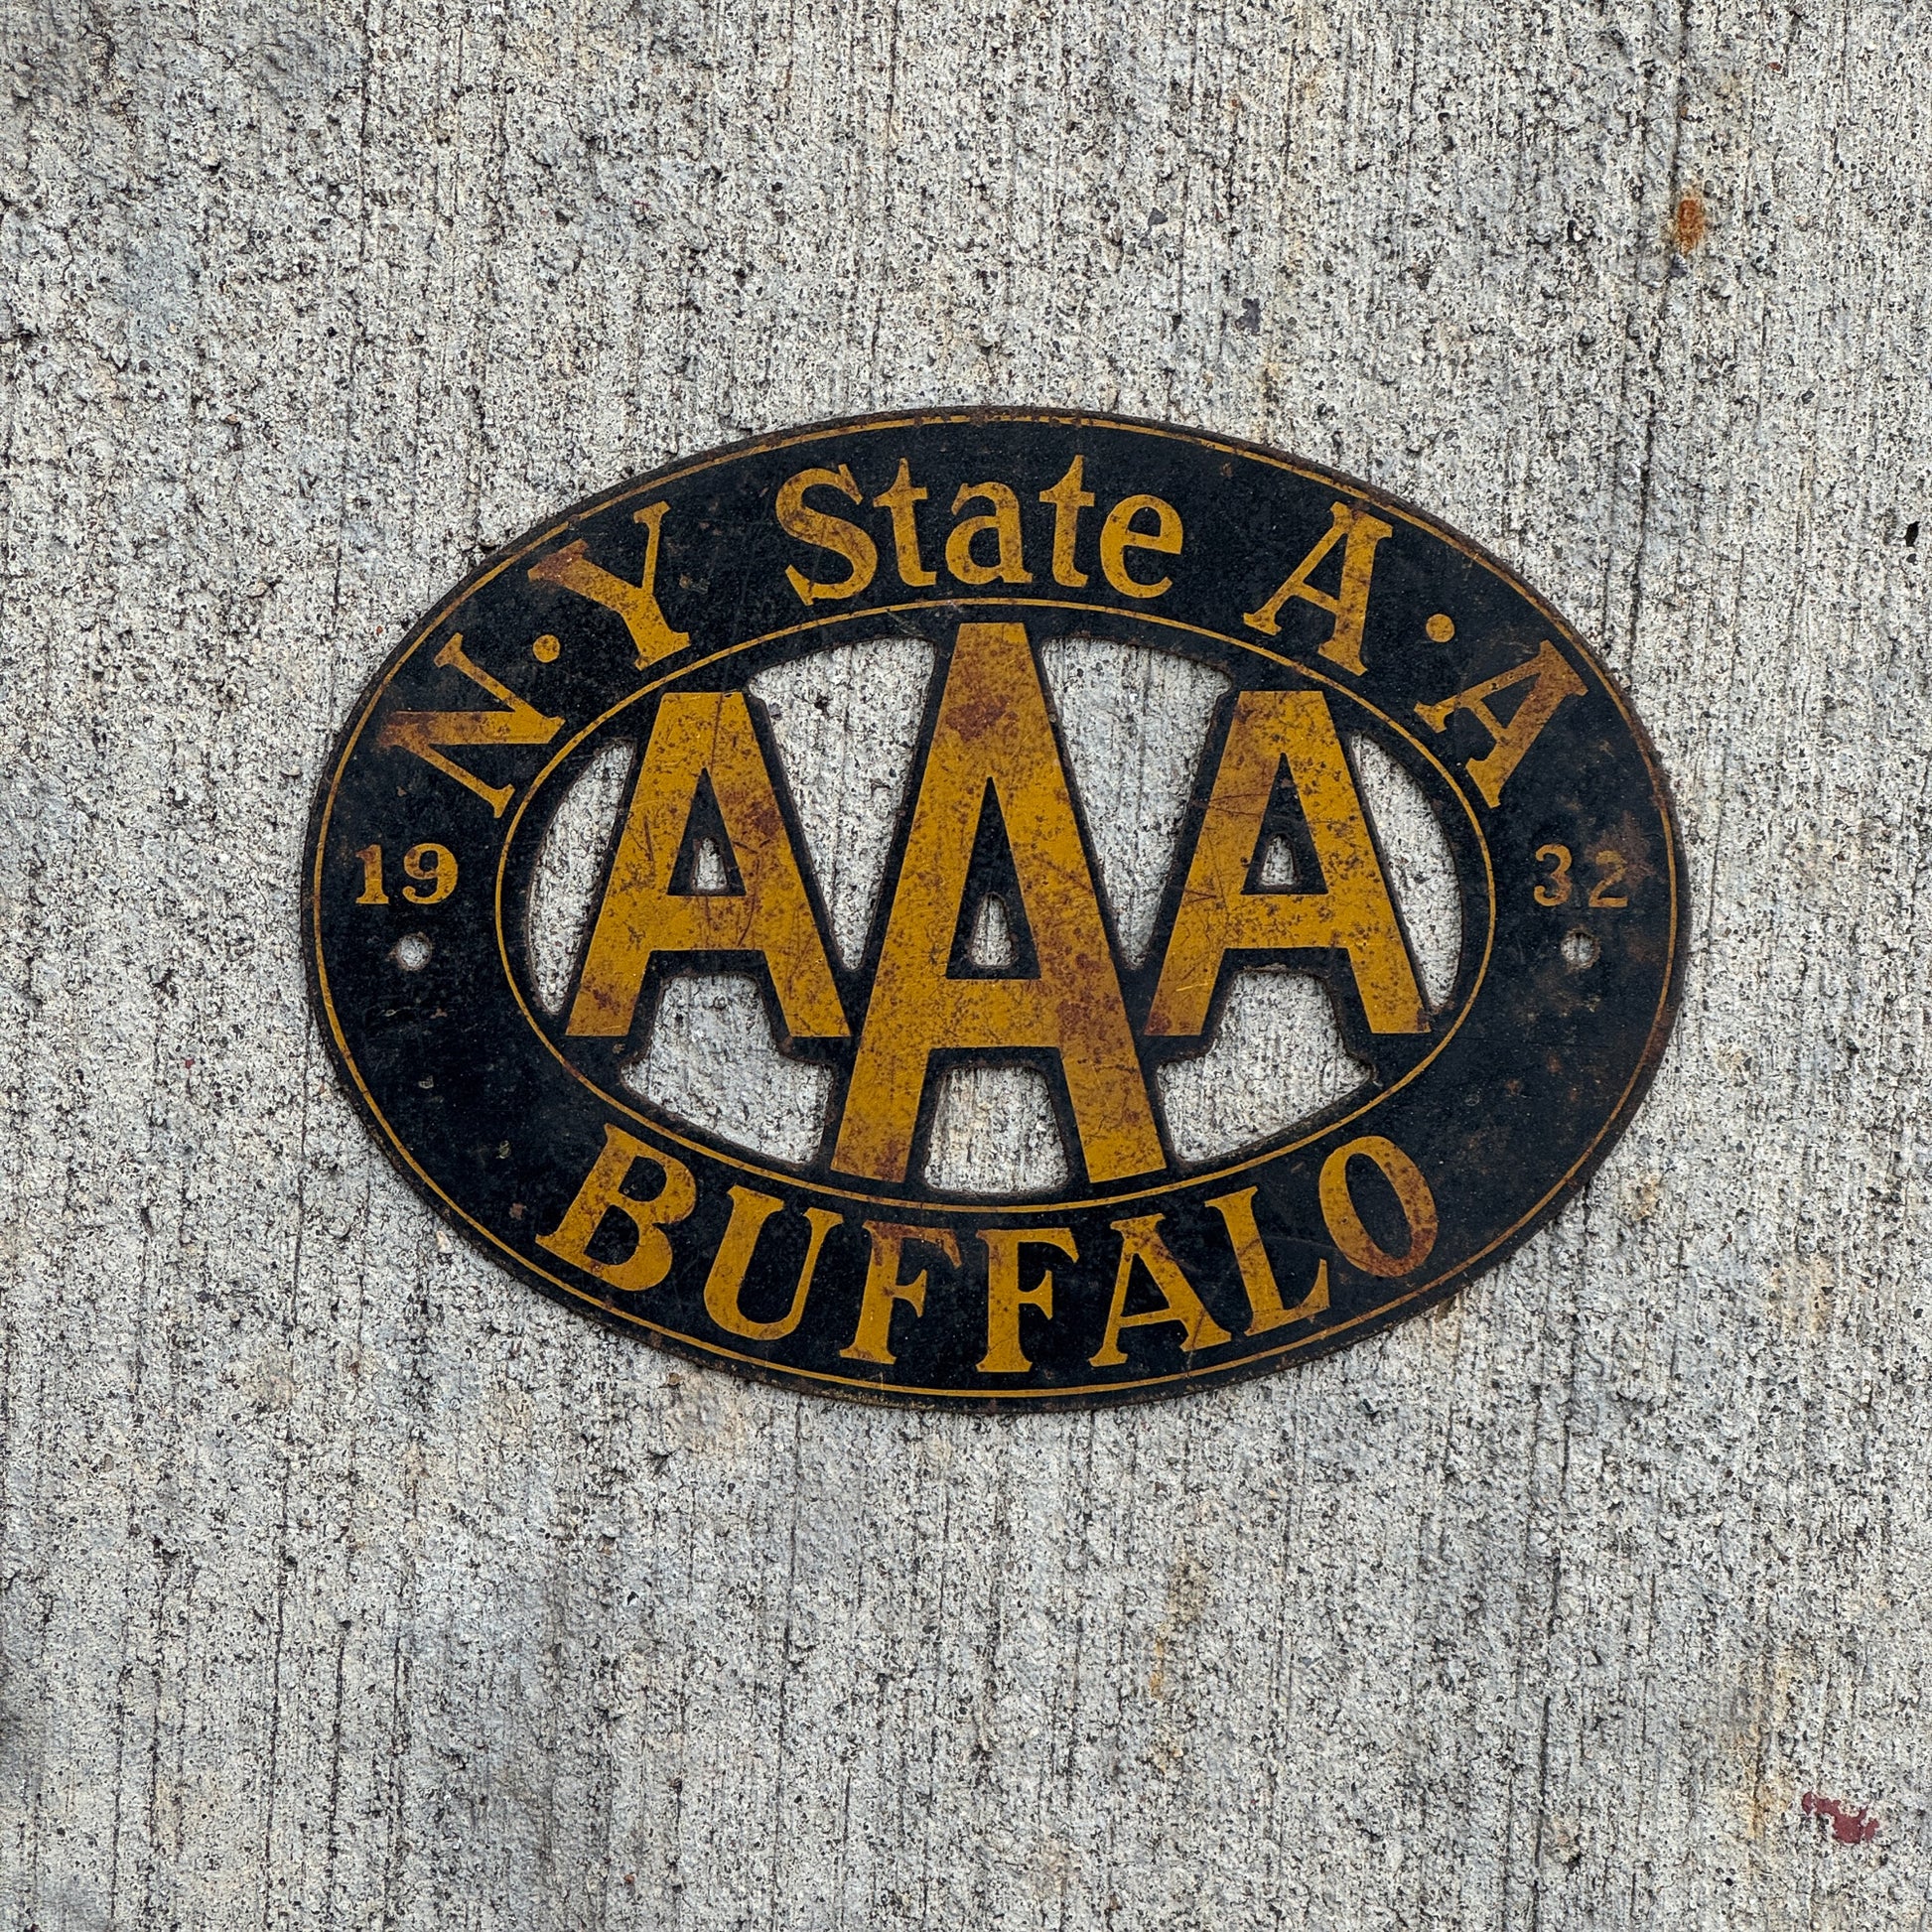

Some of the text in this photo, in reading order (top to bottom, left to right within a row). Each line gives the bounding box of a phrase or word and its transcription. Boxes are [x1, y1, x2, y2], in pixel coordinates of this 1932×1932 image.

[775, 455, 1182, 606] State
[354, 843, 1629, 908] 19 32
[567, 622, 1422, 1182] AAA
[535, 1123, 1439, 1374] BUFFALO
